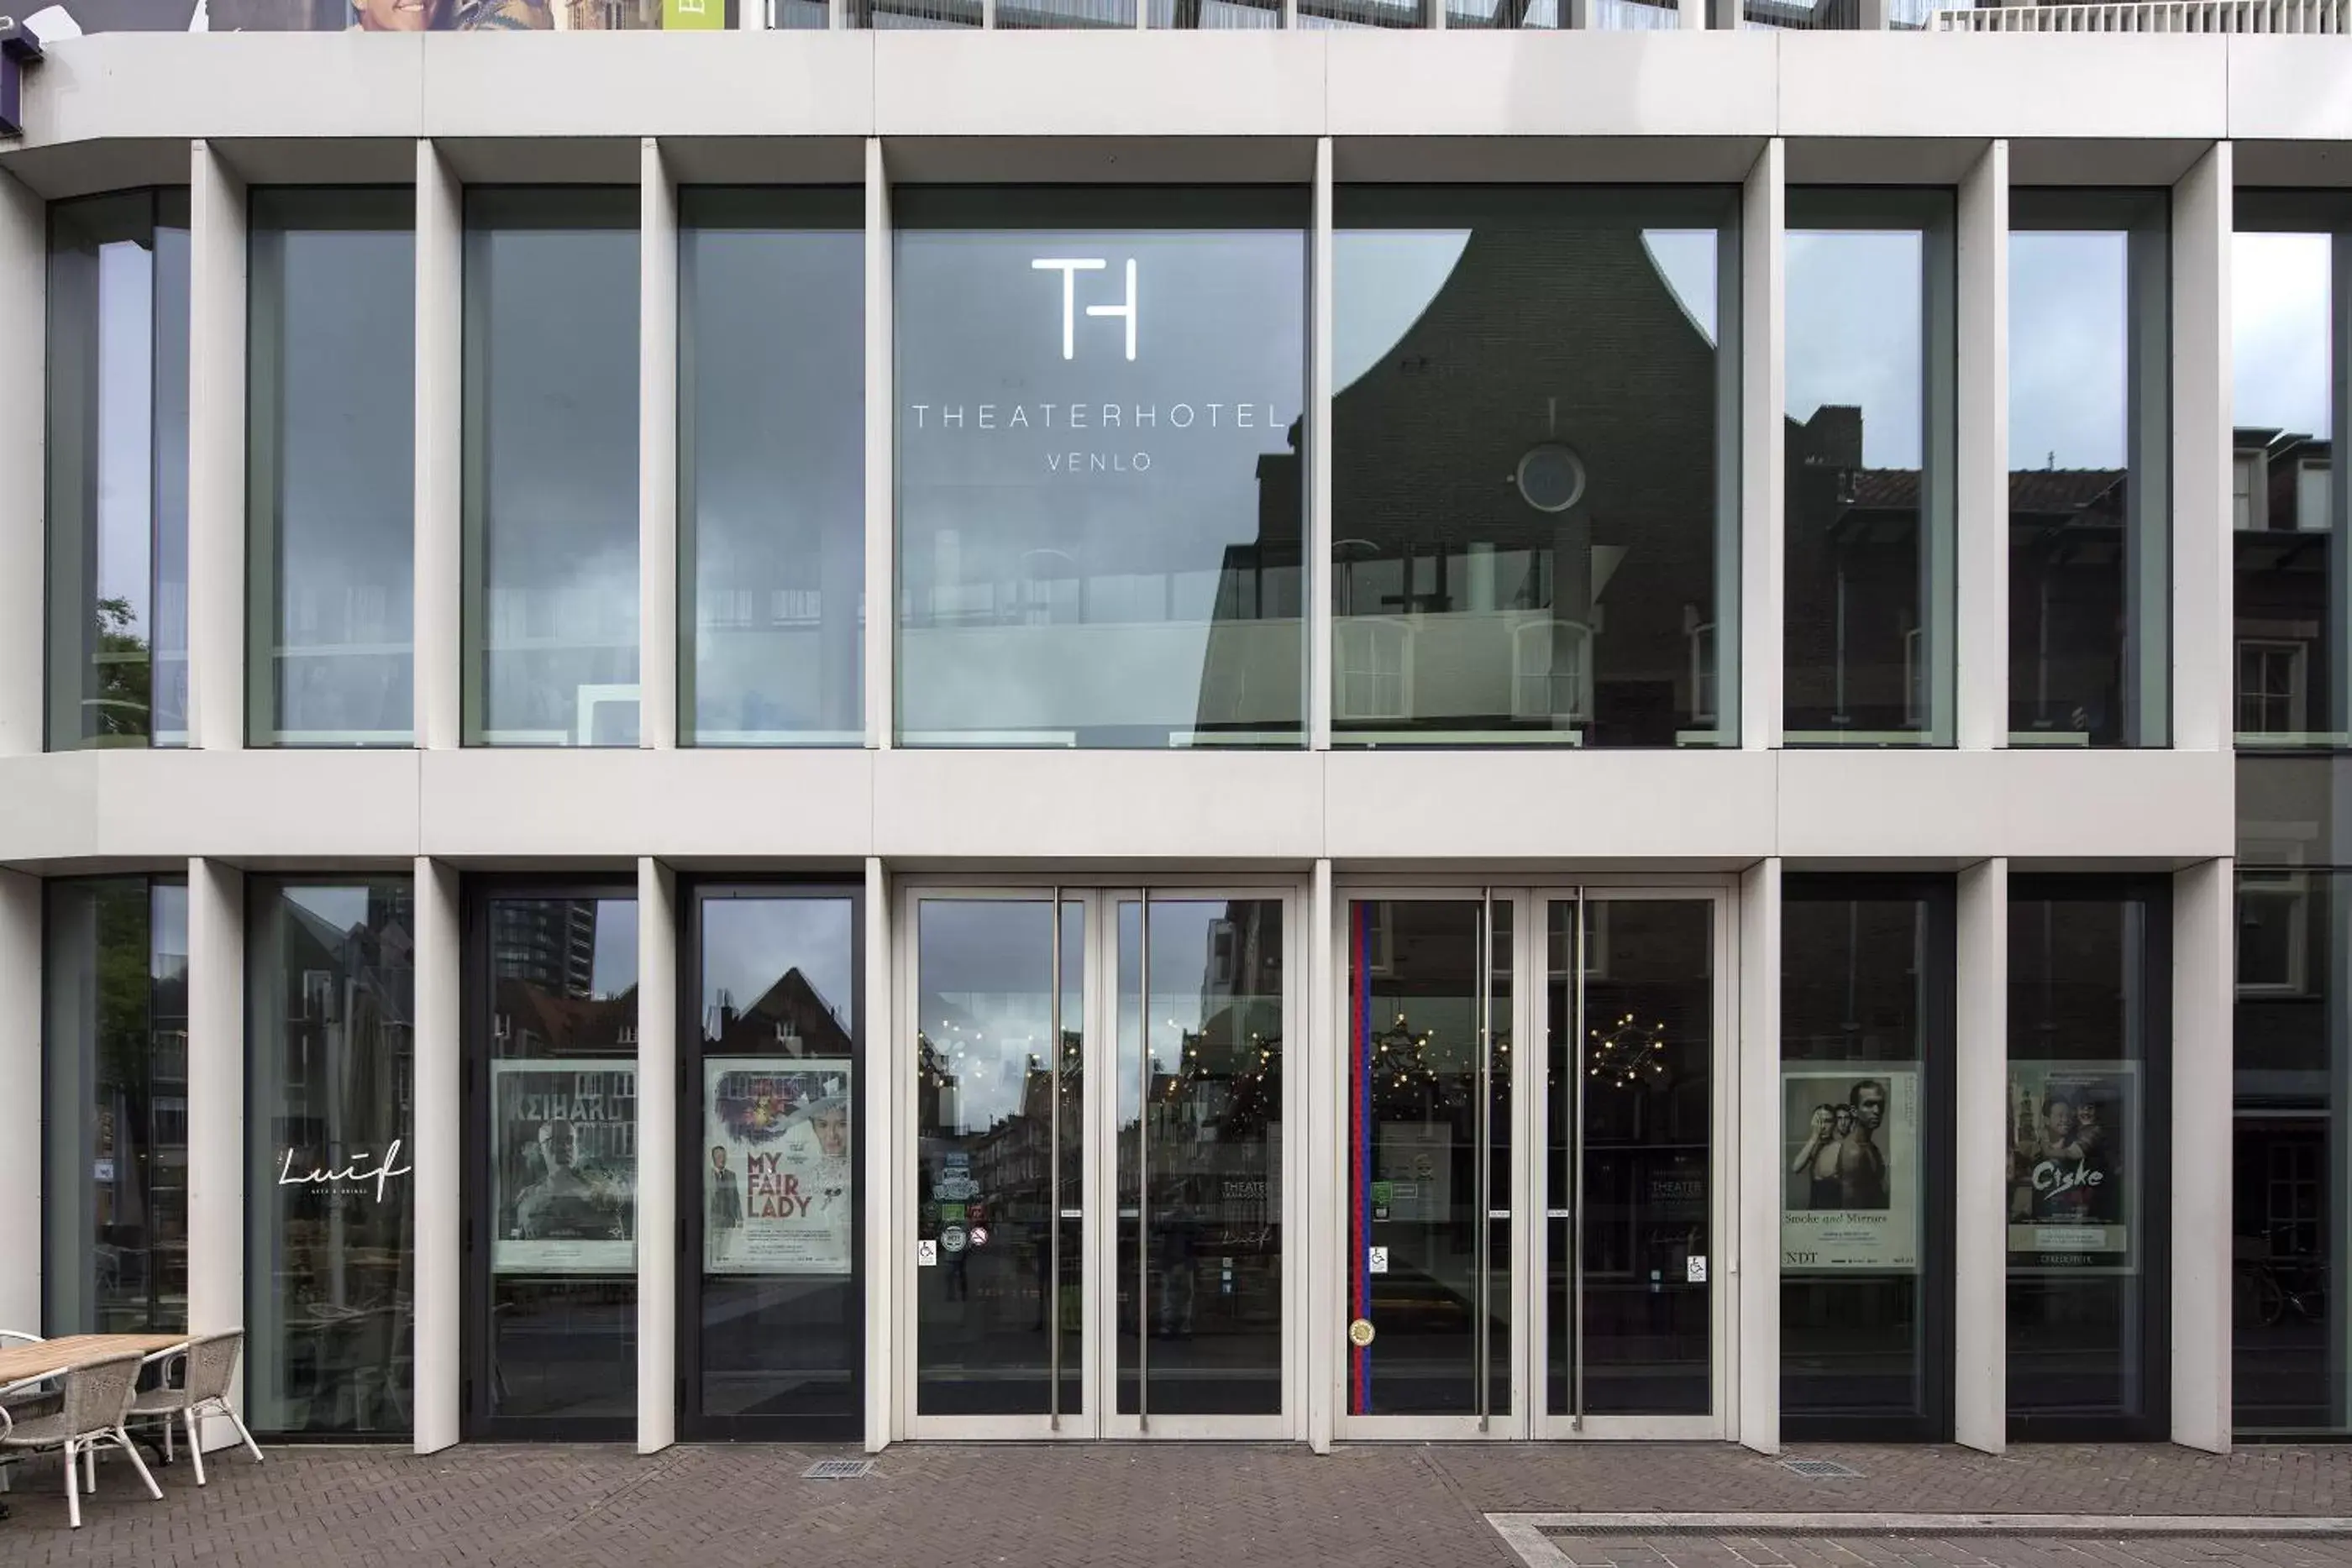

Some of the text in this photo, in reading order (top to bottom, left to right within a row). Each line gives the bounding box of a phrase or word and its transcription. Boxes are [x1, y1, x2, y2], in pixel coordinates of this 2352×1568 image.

[1032, 258, 1137, 361] TH
[911, 403, 1286, 429] THEATERHOTEL
[1047, 453, 1152, 472] VENLO
[747, 1151, 782, 1173] MY
[747, 1174, 799, 1196] FAIR
[2032, 1158, 2104, 1200] Ciske
[747, 1196, 812, 1219] LADY
[1784, 1213, 1887, 1225] Smoke and Mirrors
[1785, 1251, 1819, 1264] NDT
